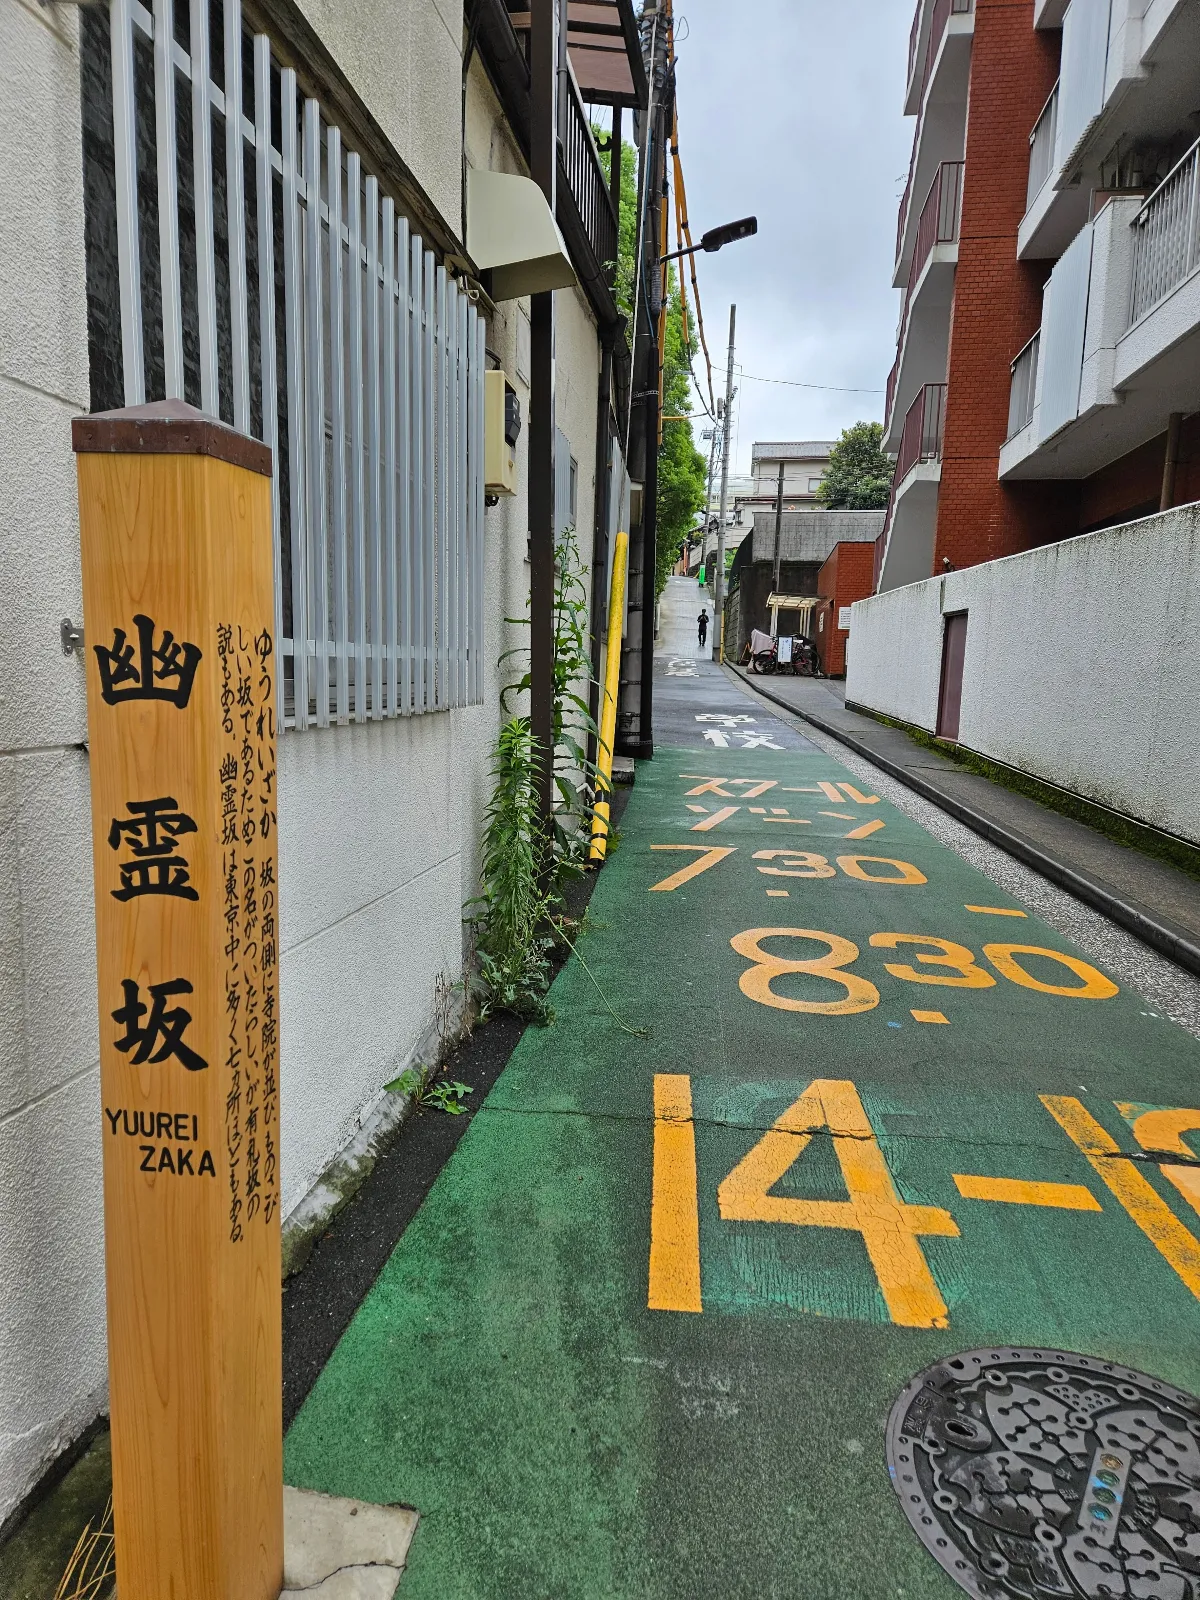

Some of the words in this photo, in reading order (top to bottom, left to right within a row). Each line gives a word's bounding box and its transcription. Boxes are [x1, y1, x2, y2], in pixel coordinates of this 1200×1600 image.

[254, 627, 277, 839] ゆうれいざか
[694, 713, 787, 750] 学校
[679, 774, 882, 804] スクール
[685, 804, 886, 840] ゾーン
[93, 613, 209, 1072] 幽霊坂
[105, 1107, 199, 1142] YUUREI
[139, 1144, 216, 1178] ZAKA
